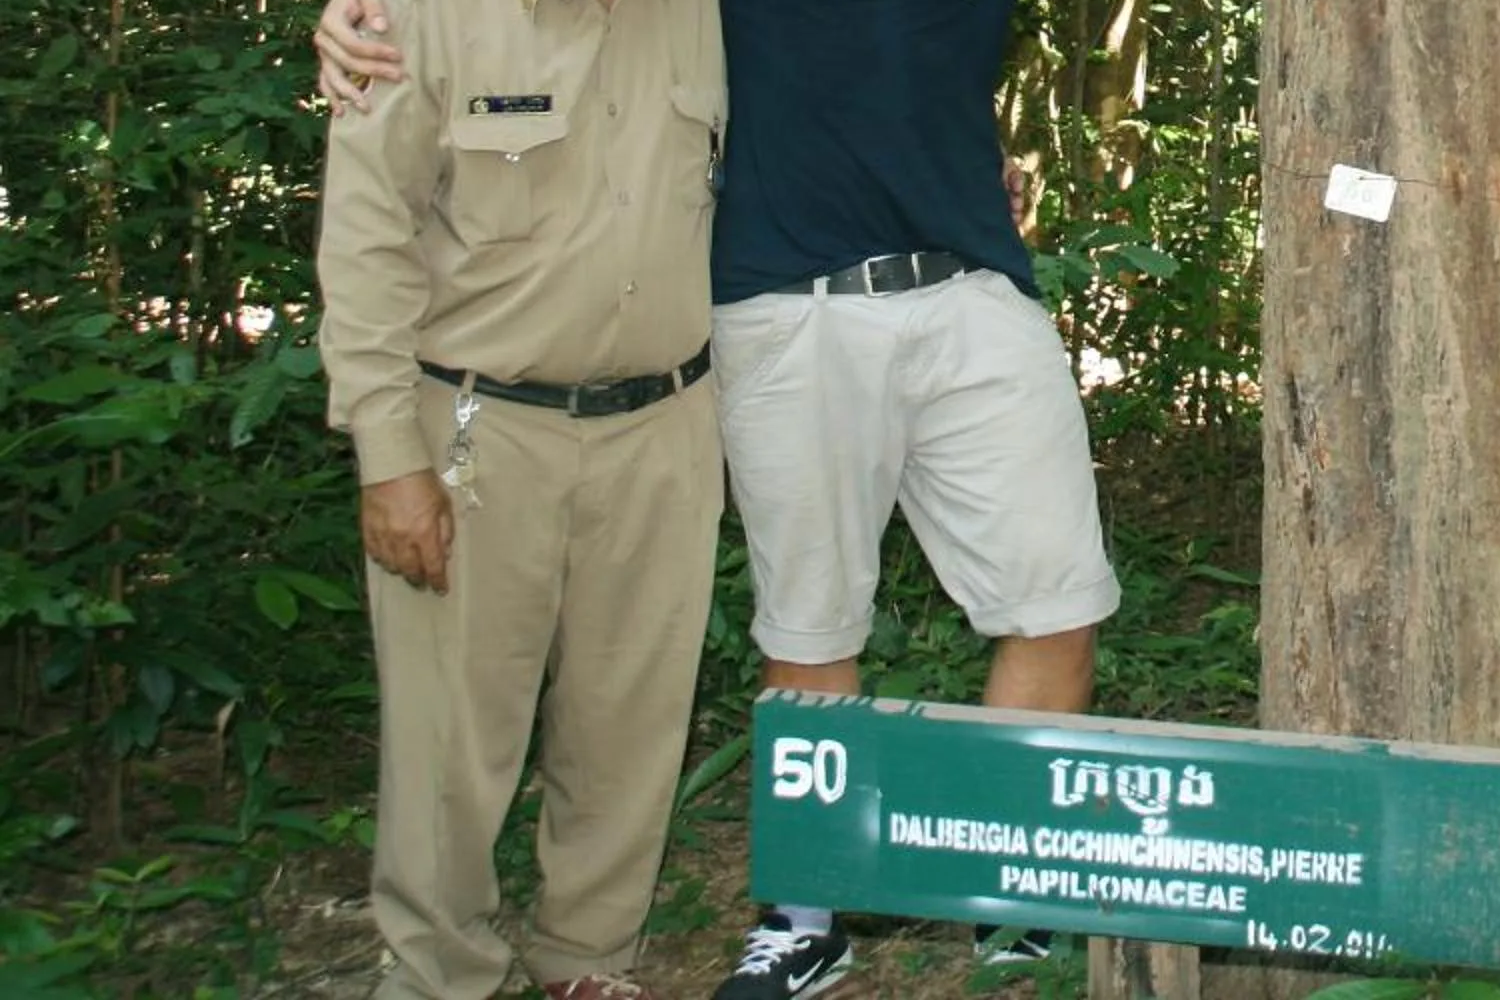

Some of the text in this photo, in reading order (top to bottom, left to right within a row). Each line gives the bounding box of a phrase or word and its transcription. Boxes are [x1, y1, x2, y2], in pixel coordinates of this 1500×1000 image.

[772, 736, 848, 805] 50
[889, 812, 1029, 857] DALBERGIA
[1000, 864, 1248, 913] PAPILIONACEAE
